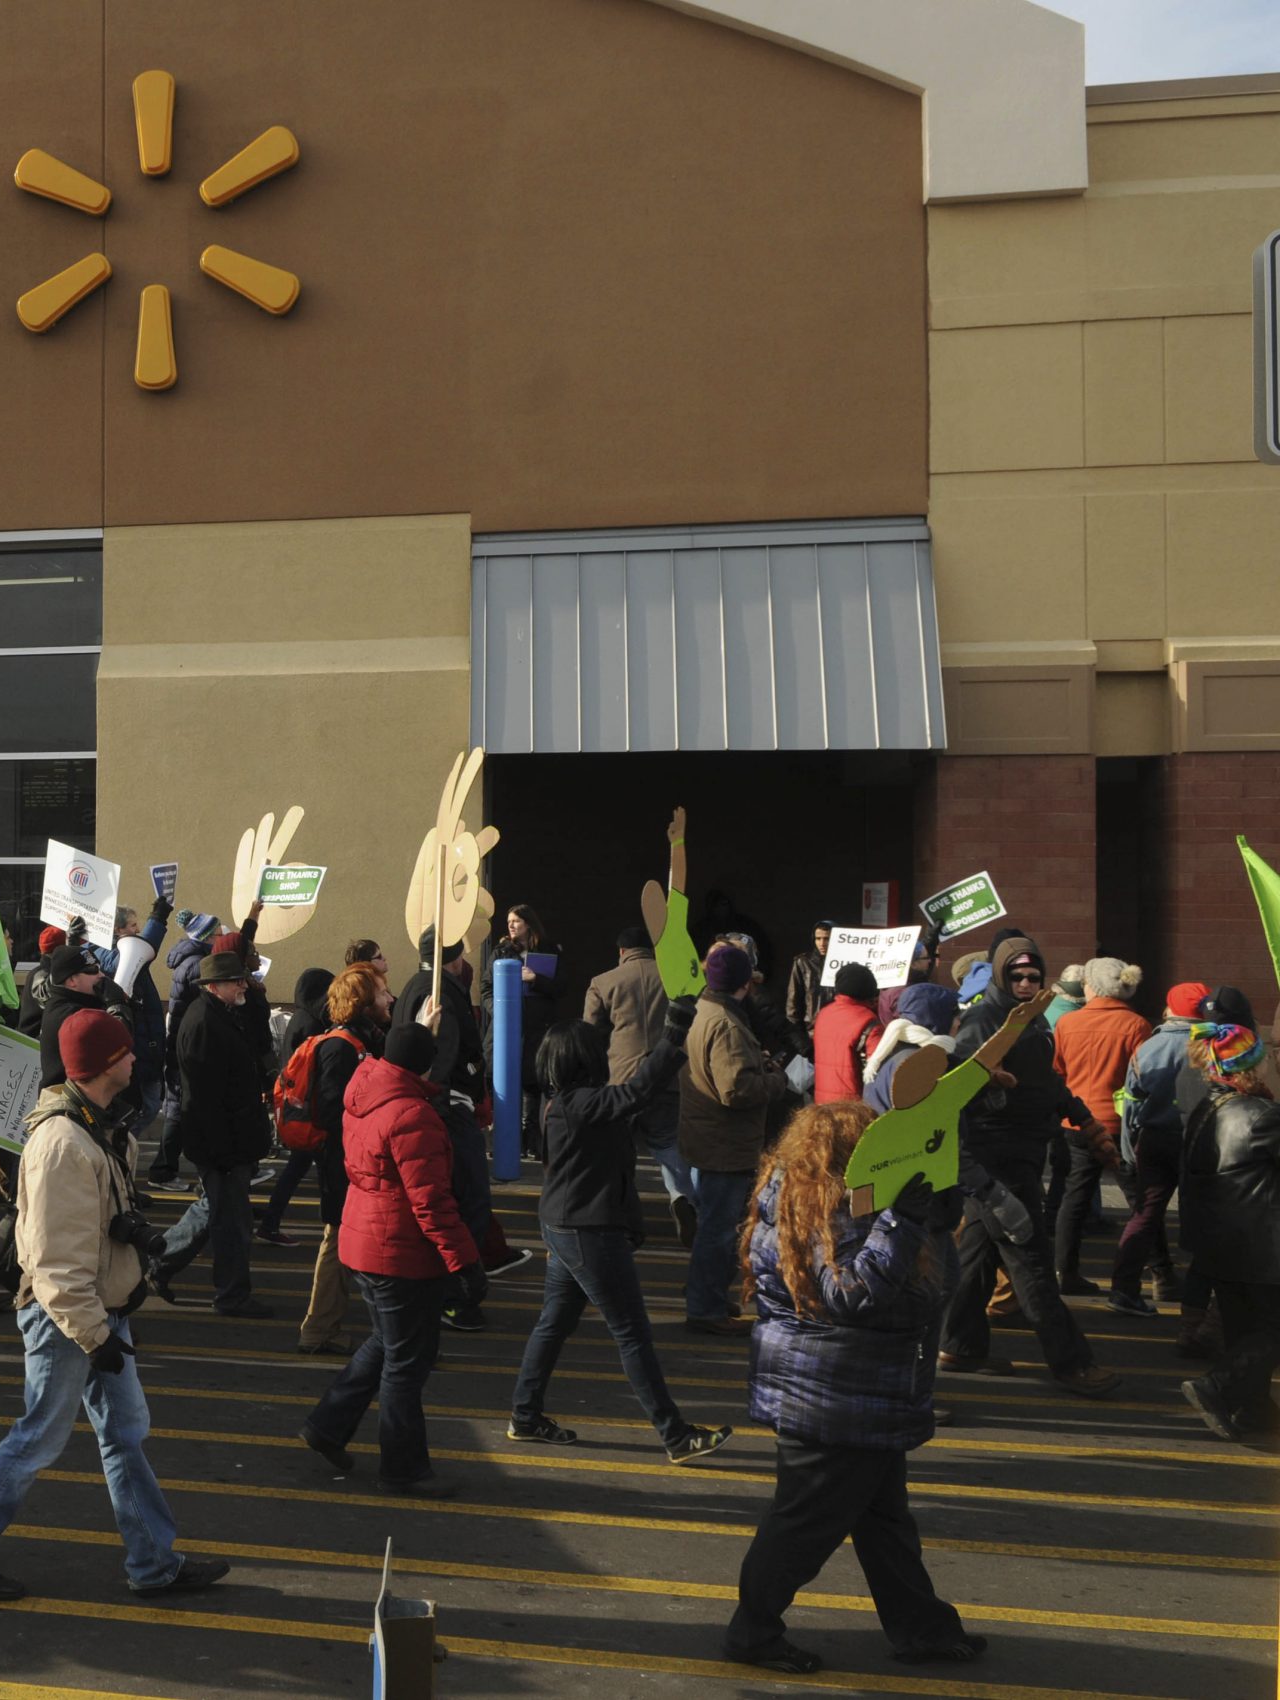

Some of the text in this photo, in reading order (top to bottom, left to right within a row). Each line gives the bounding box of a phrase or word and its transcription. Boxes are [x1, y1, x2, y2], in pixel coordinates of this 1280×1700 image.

[265, 870, 319, 880] GIVE THANKS
[279, 882, 300, 890] SHOP
[928, 880, 986, 913] GIVE THANKS
[951, 898, 974, 915] SHOP
[897, 931, 911, 944] Up
[867, 948, 885, 959] for
